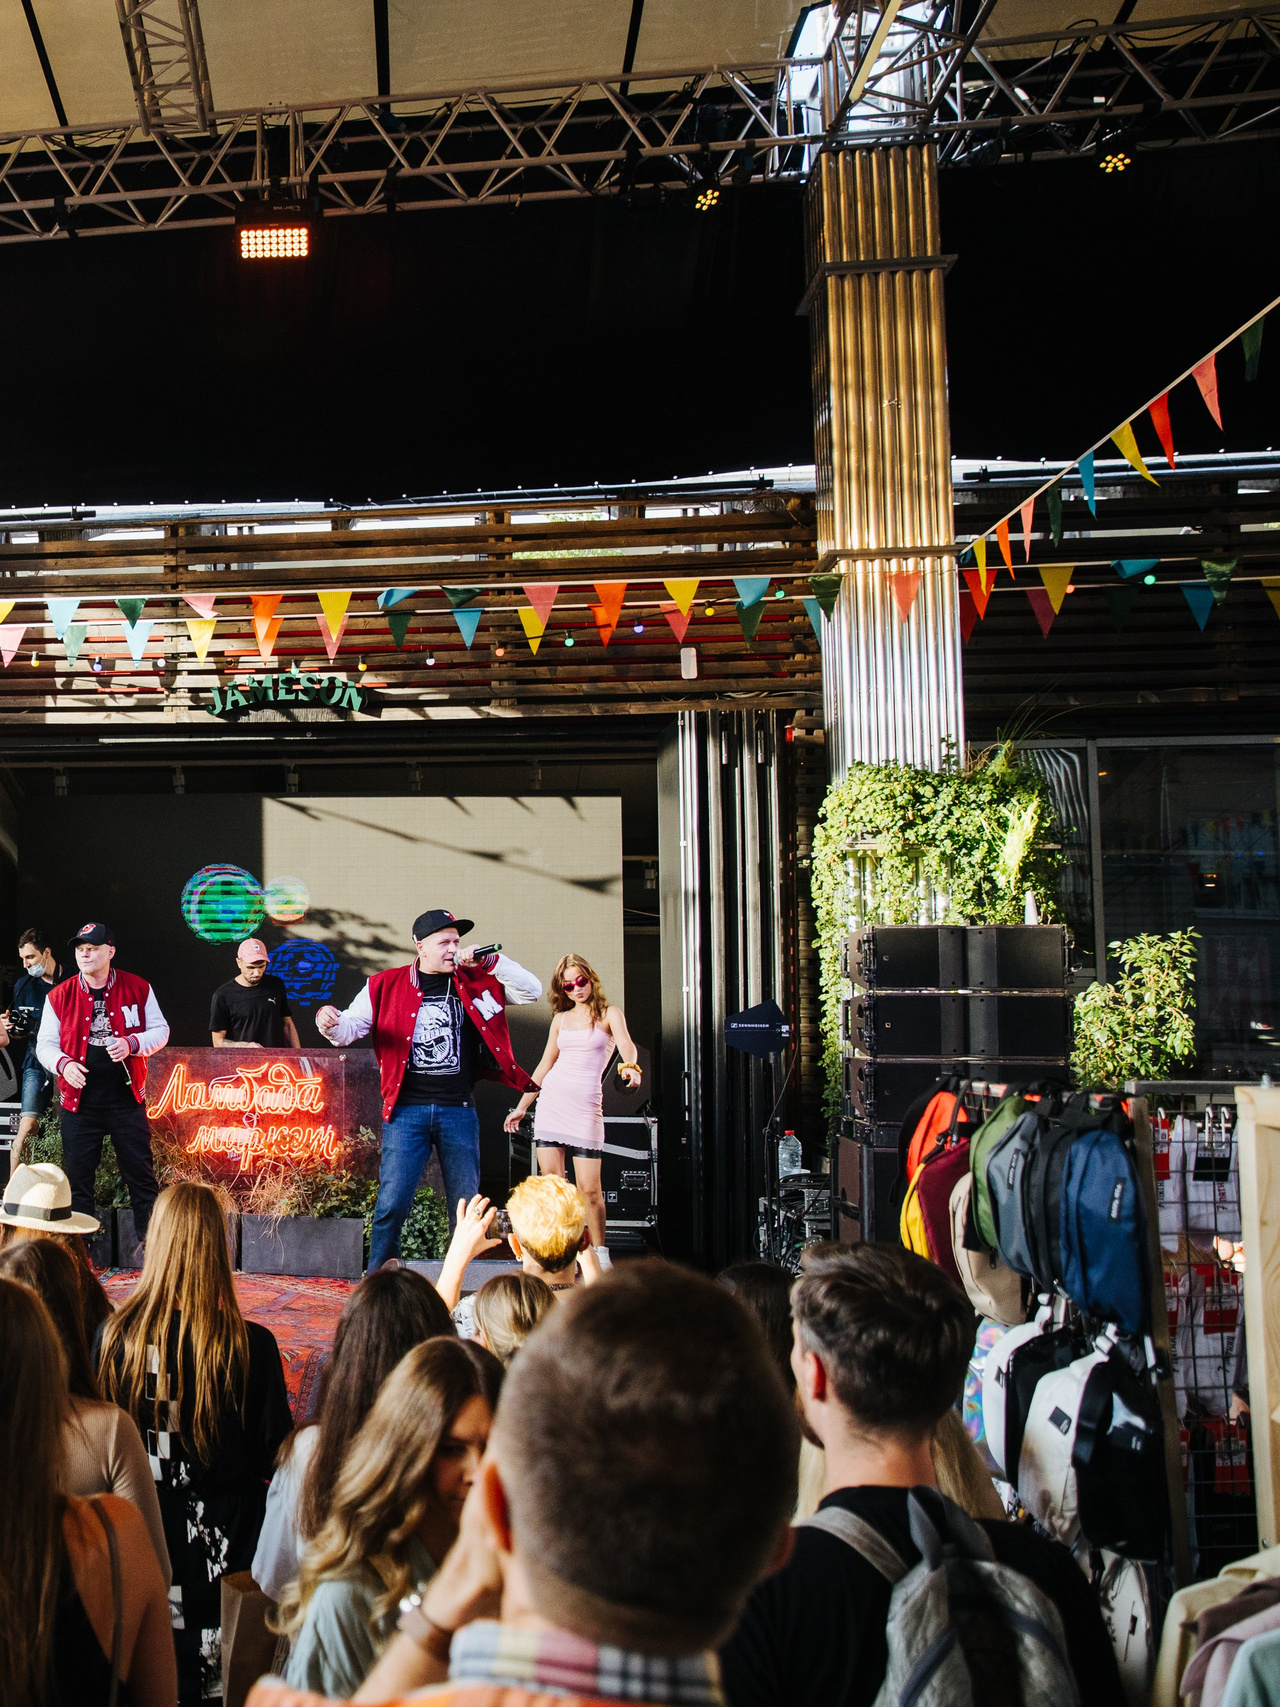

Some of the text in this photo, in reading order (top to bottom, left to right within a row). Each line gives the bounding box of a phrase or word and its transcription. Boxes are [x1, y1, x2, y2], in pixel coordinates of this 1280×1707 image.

[206, 672, 367, 716] JAMESON
[120, 1004, 140, 1028] M
[472, 989, 503, 1021] M
